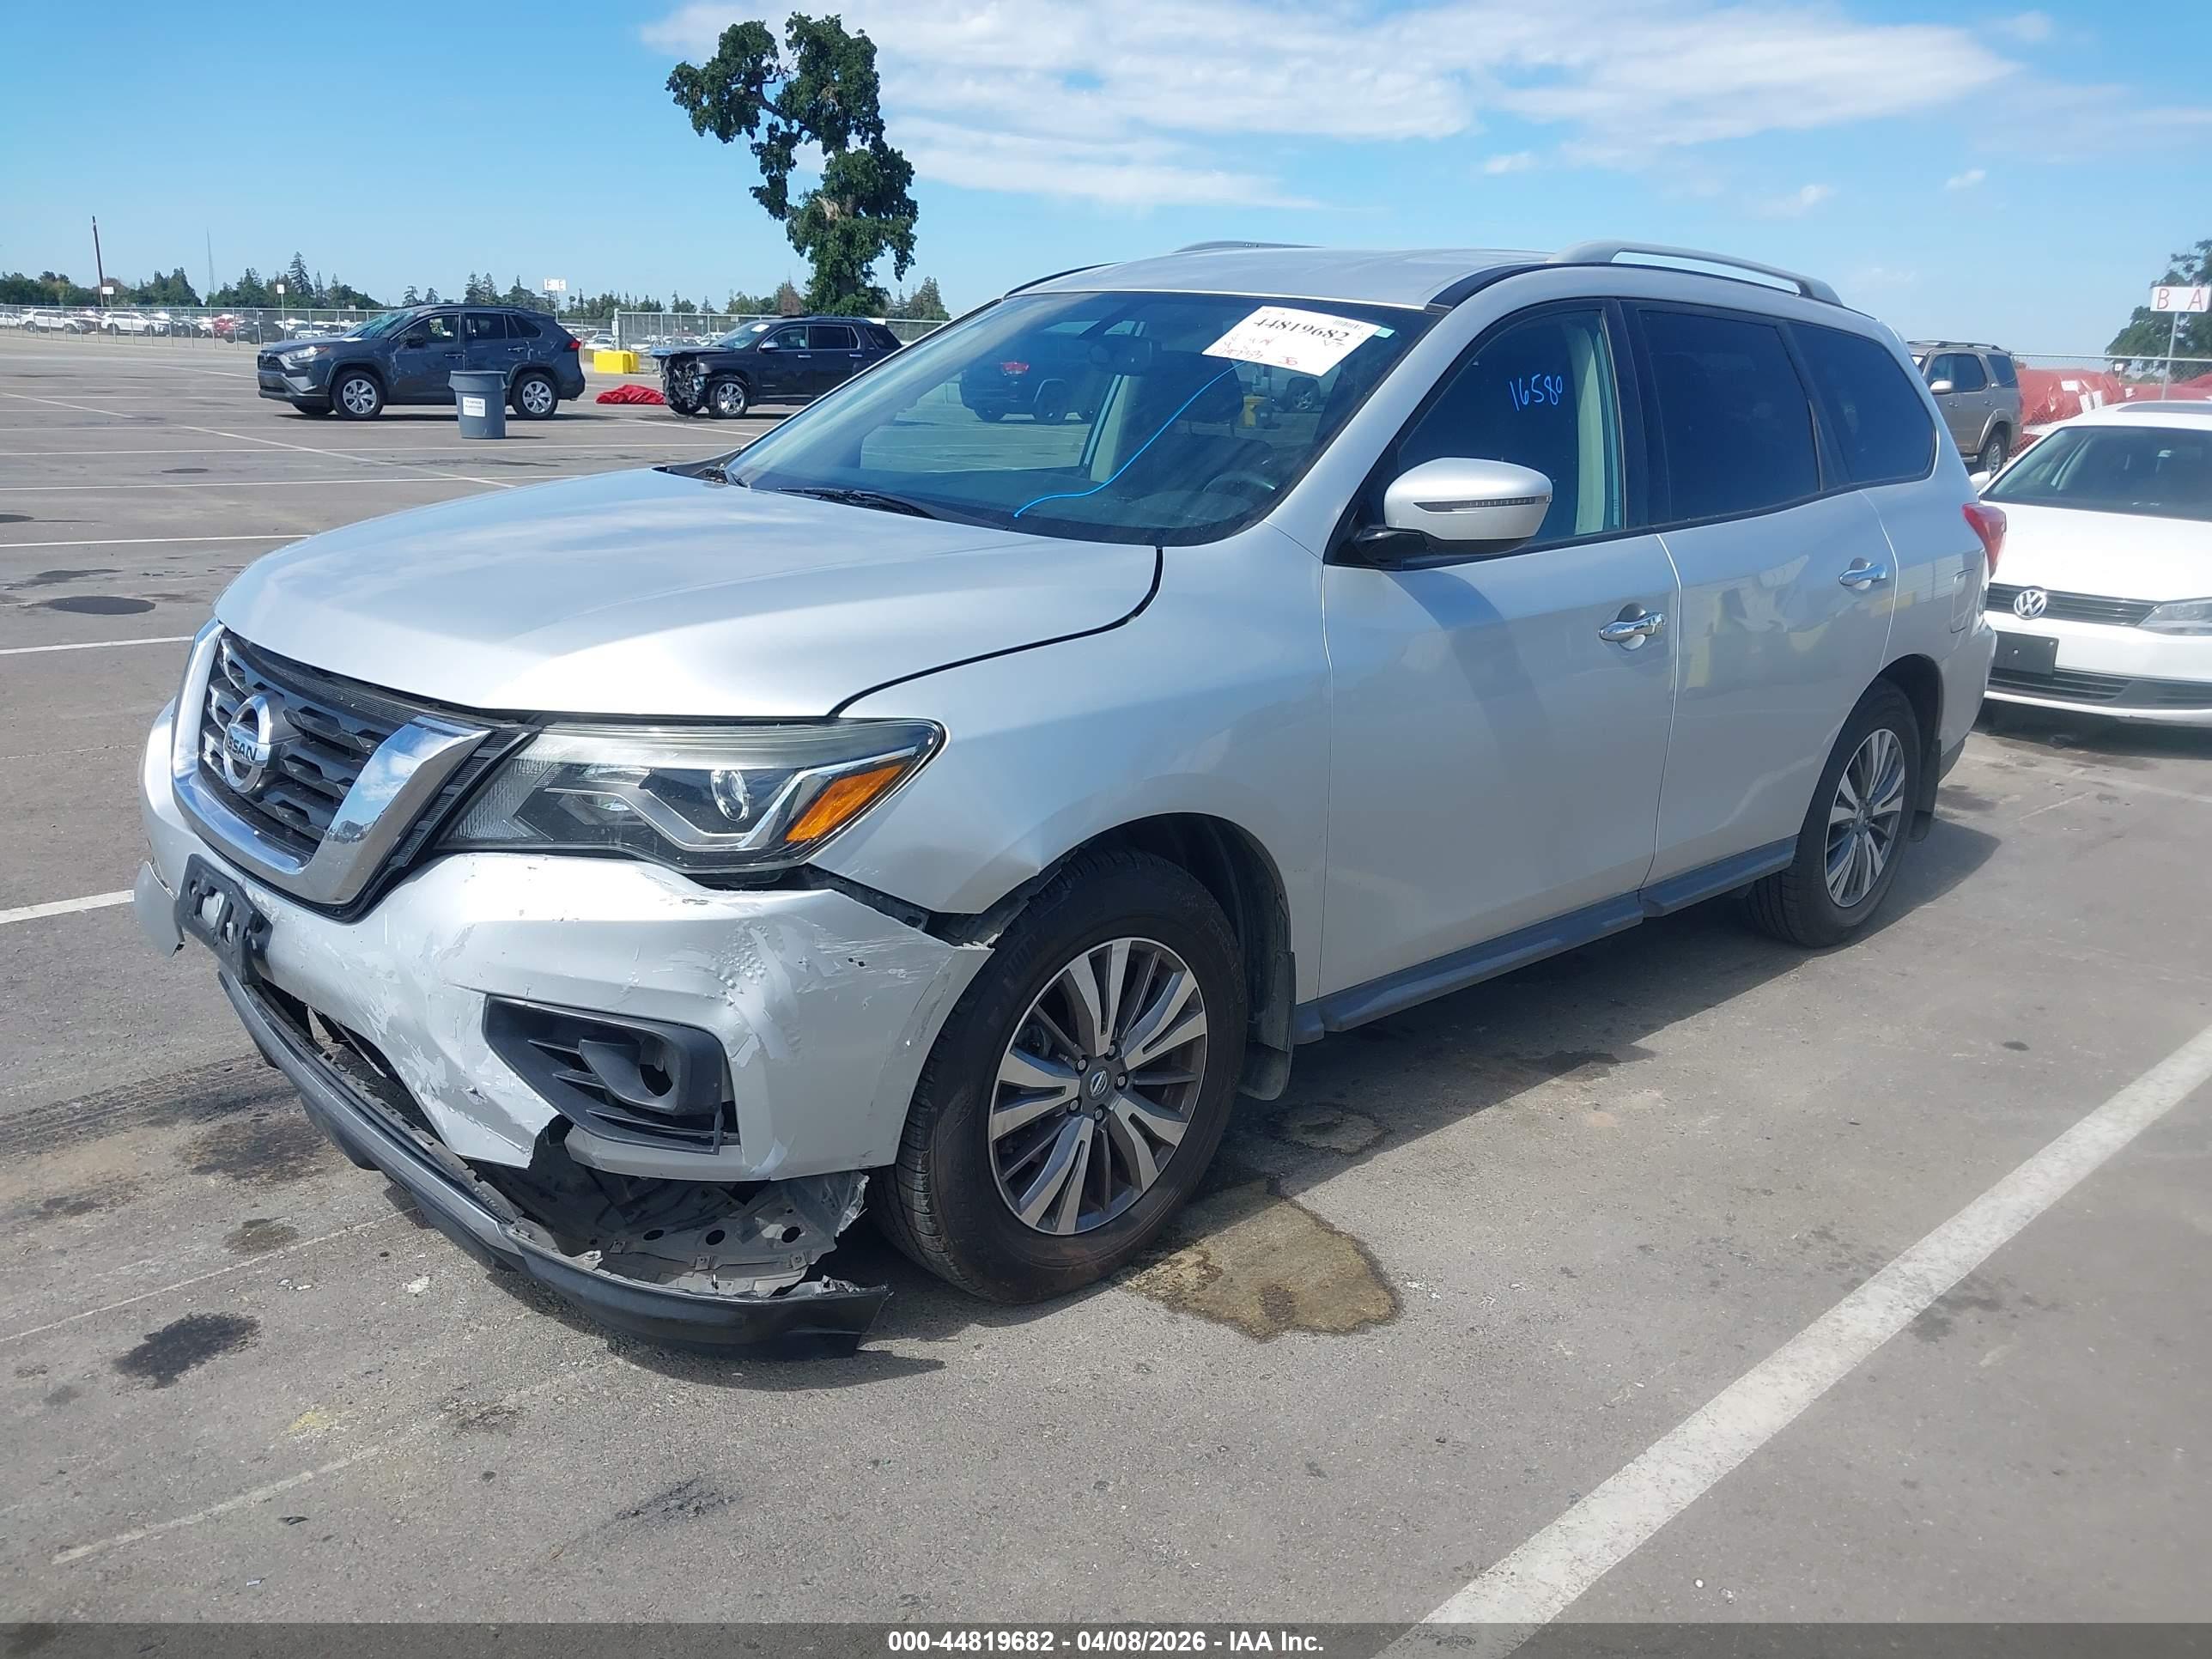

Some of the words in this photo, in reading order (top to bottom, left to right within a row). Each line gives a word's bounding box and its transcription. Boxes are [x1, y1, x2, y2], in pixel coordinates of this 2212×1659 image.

[2156, 288, 2170, 310] B
[2187, 289, 2203, 311] A
[1253, 318, 1351, 342] 44819682
[1510, 374, 1563, 411] 16580
